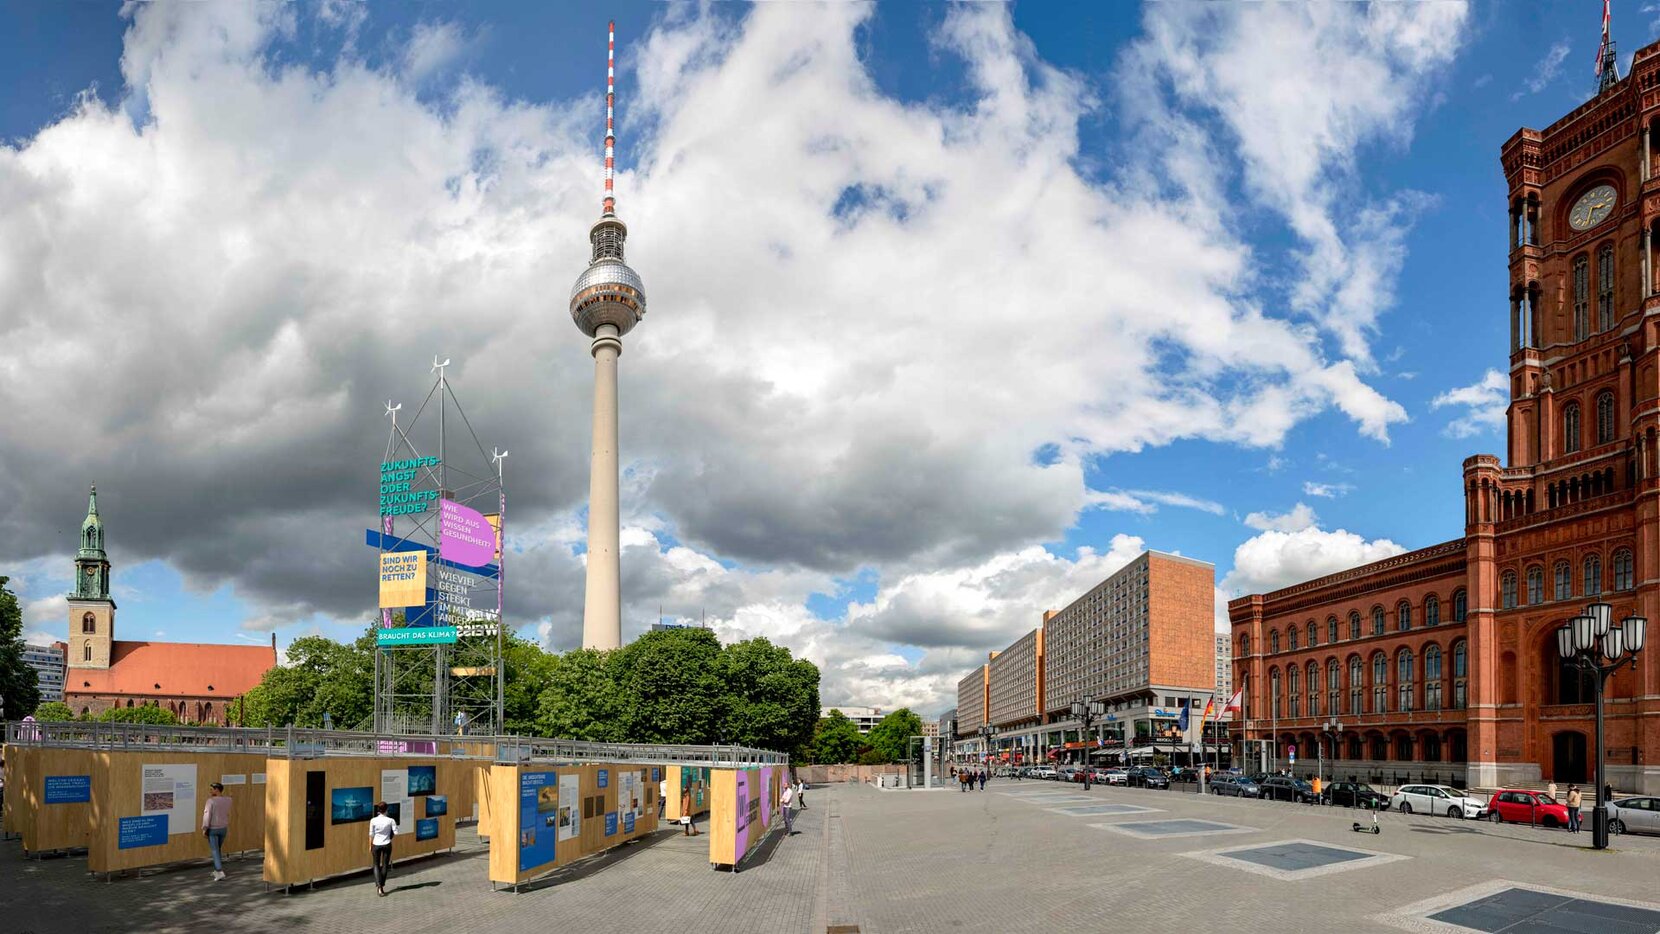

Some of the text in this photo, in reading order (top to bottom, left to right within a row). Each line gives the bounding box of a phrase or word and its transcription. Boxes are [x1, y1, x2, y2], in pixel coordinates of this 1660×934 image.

[381, 457, 441, 472] ZUKUNFTS-
[381, 470, 417, 483] ANGST
[380, 482, 410, 494] ODER
[380, 490, 440, 507] ZUKUNFTS-
[380, 502, 428, 518] FREUDE?
[443, 502, 459, 513] WIE
[443, 511, 480, 529] WIRD AUS
[443, 519, 471, 534] WISSEN
[443, 528, 491, 547] GESUNDHEIT?
[382, 555, 418, 565] SIND WIR
[382, 565, 405, 573] NOCH
[382, 572, 415, 581] RETTEN?
[439, 570, 476, 587] WIEVIEL
[439, 581, 467, 595] GEGEN
[439, 592, 471, 607] STECKT
[378, 632, 410, 640] BRAUCHT
